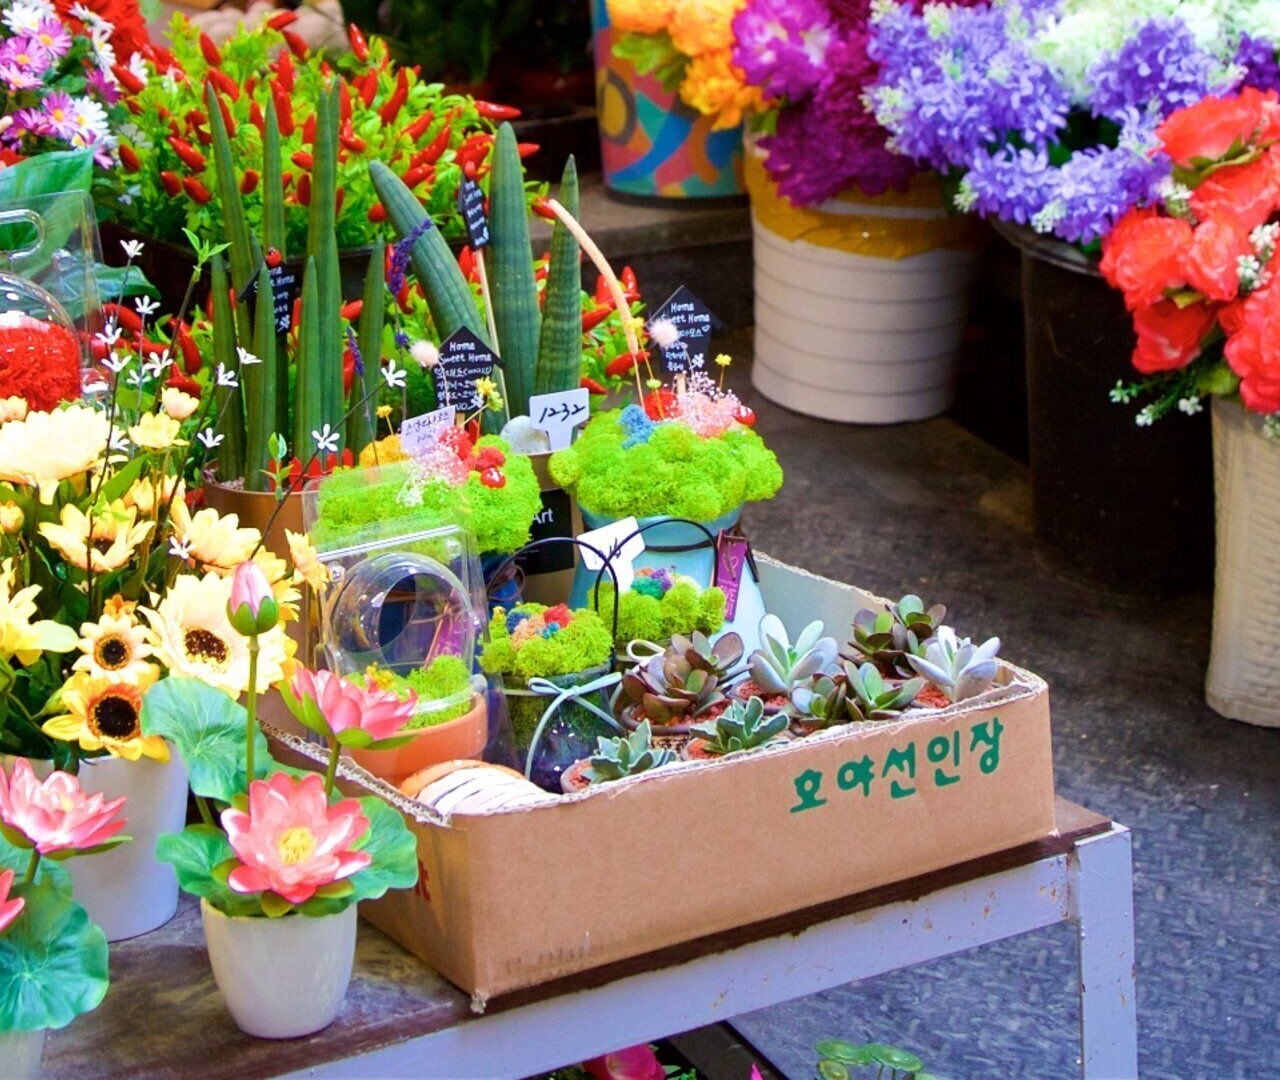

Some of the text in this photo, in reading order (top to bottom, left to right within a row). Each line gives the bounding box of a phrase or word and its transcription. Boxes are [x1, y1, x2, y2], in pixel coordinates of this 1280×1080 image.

[449, 341, 476, 352] Home
[468, 352, 492, 363] Home
[789, 716, 1005, 814] 호야선인장
